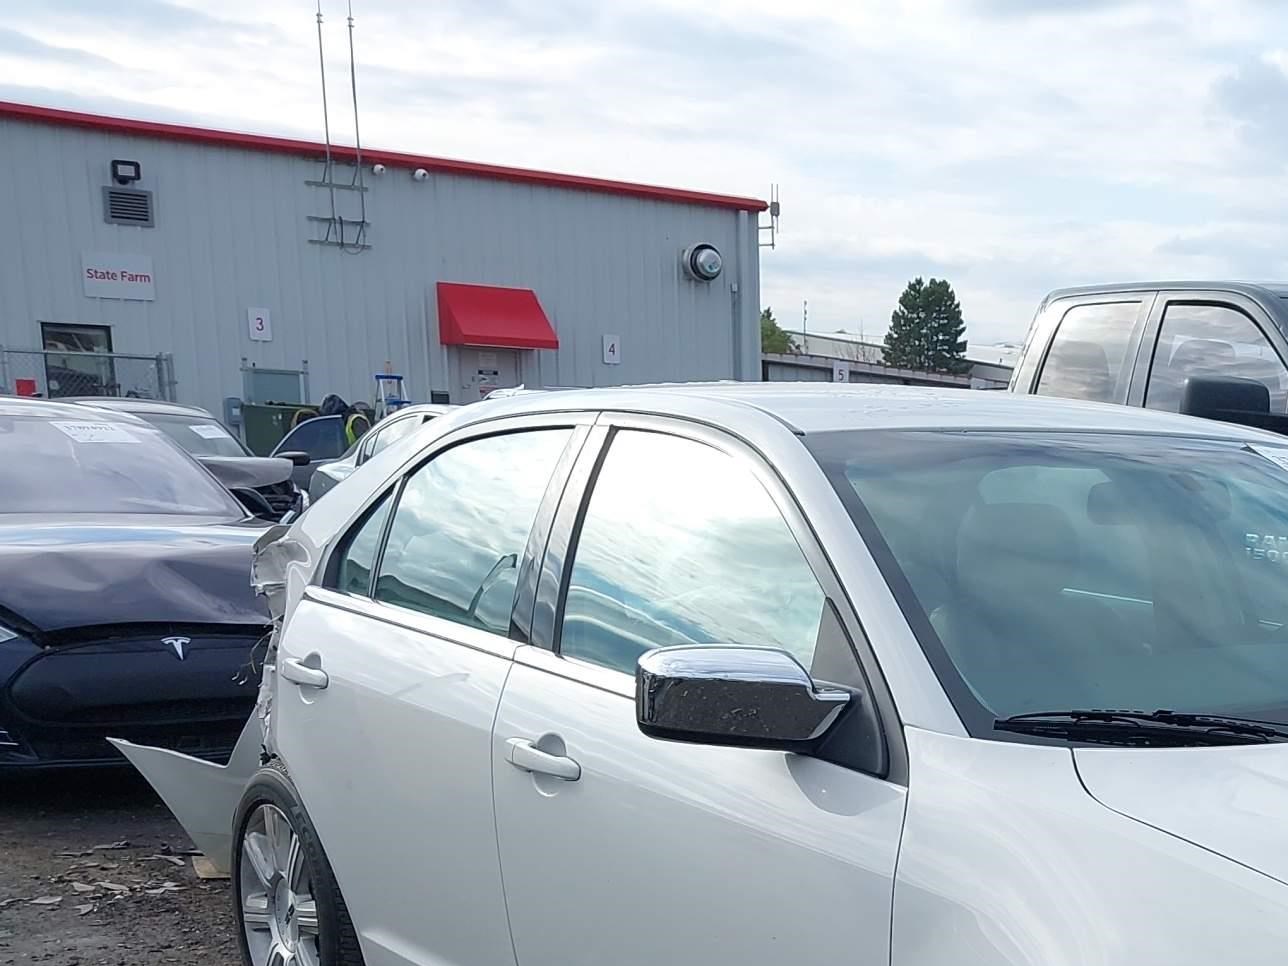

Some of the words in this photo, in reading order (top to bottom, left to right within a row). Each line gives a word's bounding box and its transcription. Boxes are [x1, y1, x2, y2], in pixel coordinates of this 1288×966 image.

[86, 268, 118, 281] State
[120, 270, 151, 283] Farm
[255, 317, 264, 331] 3
[608, 343, 615, 356] 4
[838, 369, 844, 381] 5
